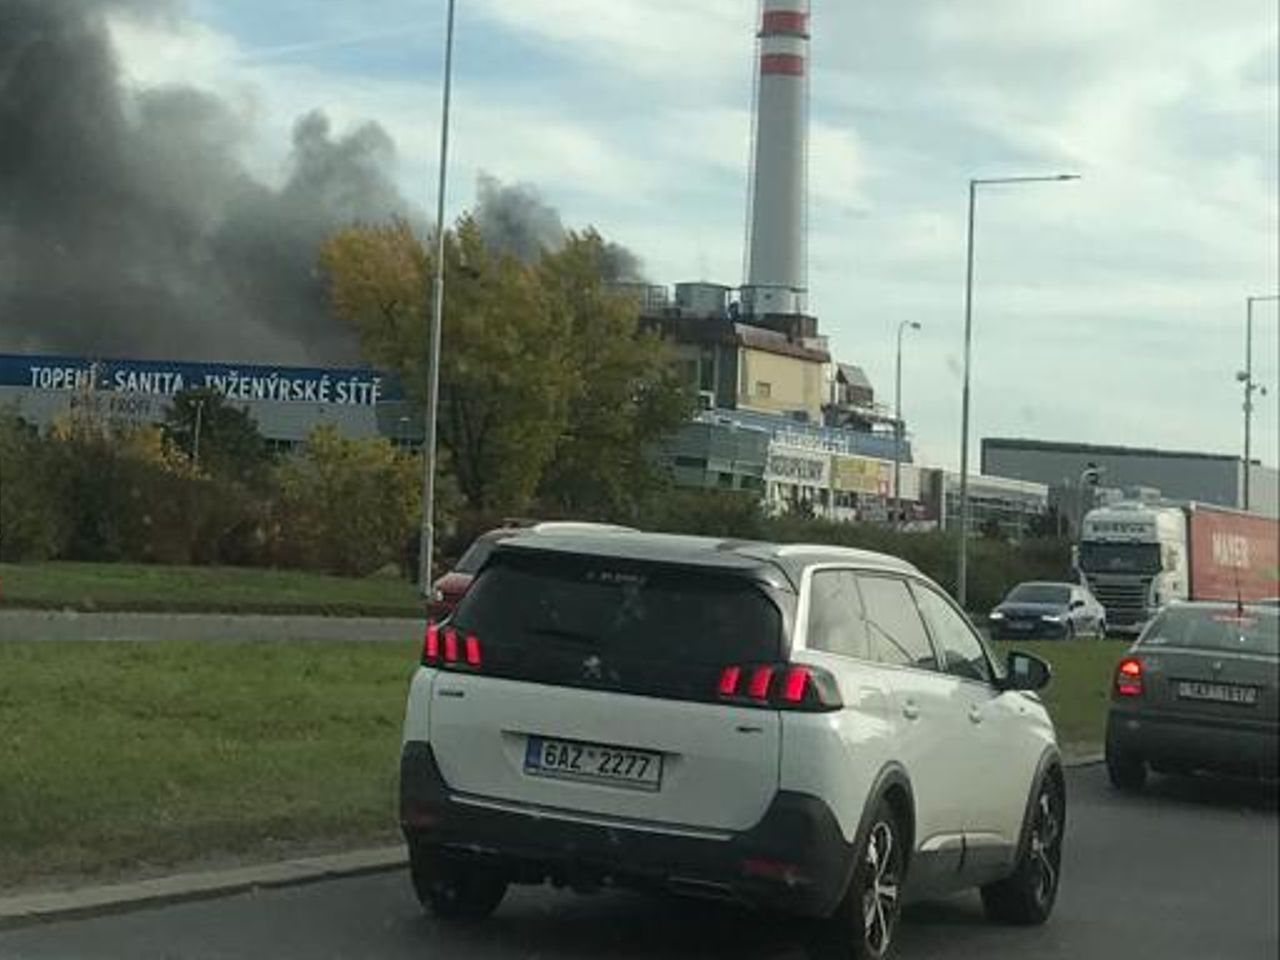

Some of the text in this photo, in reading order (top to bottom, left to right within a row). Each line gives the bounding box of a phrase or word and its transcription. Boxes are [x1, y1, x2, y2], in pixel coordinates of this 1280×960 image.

[115, 369, 184, 396] SANITA
[544, 743, 651, 778] 6AZ 2277
